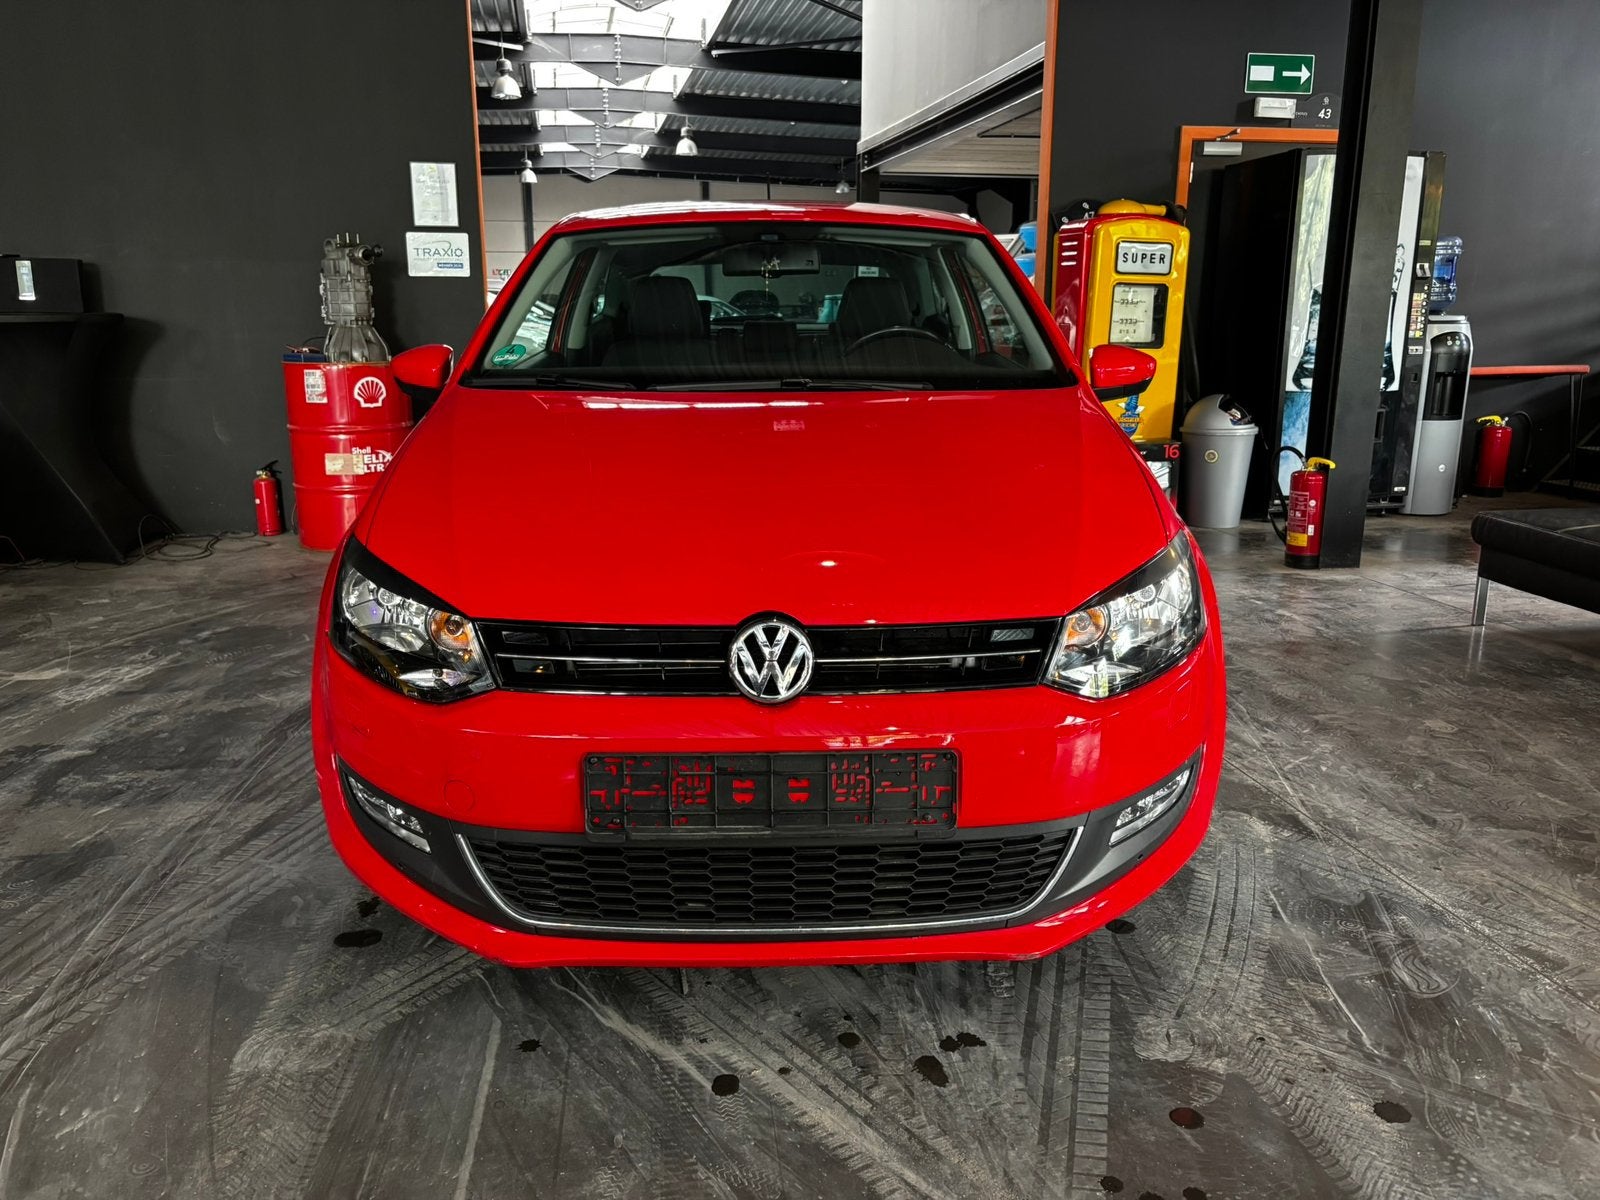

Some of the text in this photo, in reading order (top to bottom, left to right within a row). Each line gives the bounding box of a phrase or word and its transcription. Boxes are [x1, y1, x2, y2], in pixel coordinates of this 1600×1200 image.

[1318, 108, 1332, 119] 43
[413, 247, 464, 257] TRAXIO
[1122, 252, 1166, 264] SUPER
[352, 446, 371, 455] Shell
[1163, 444, 1180, 459] 16
